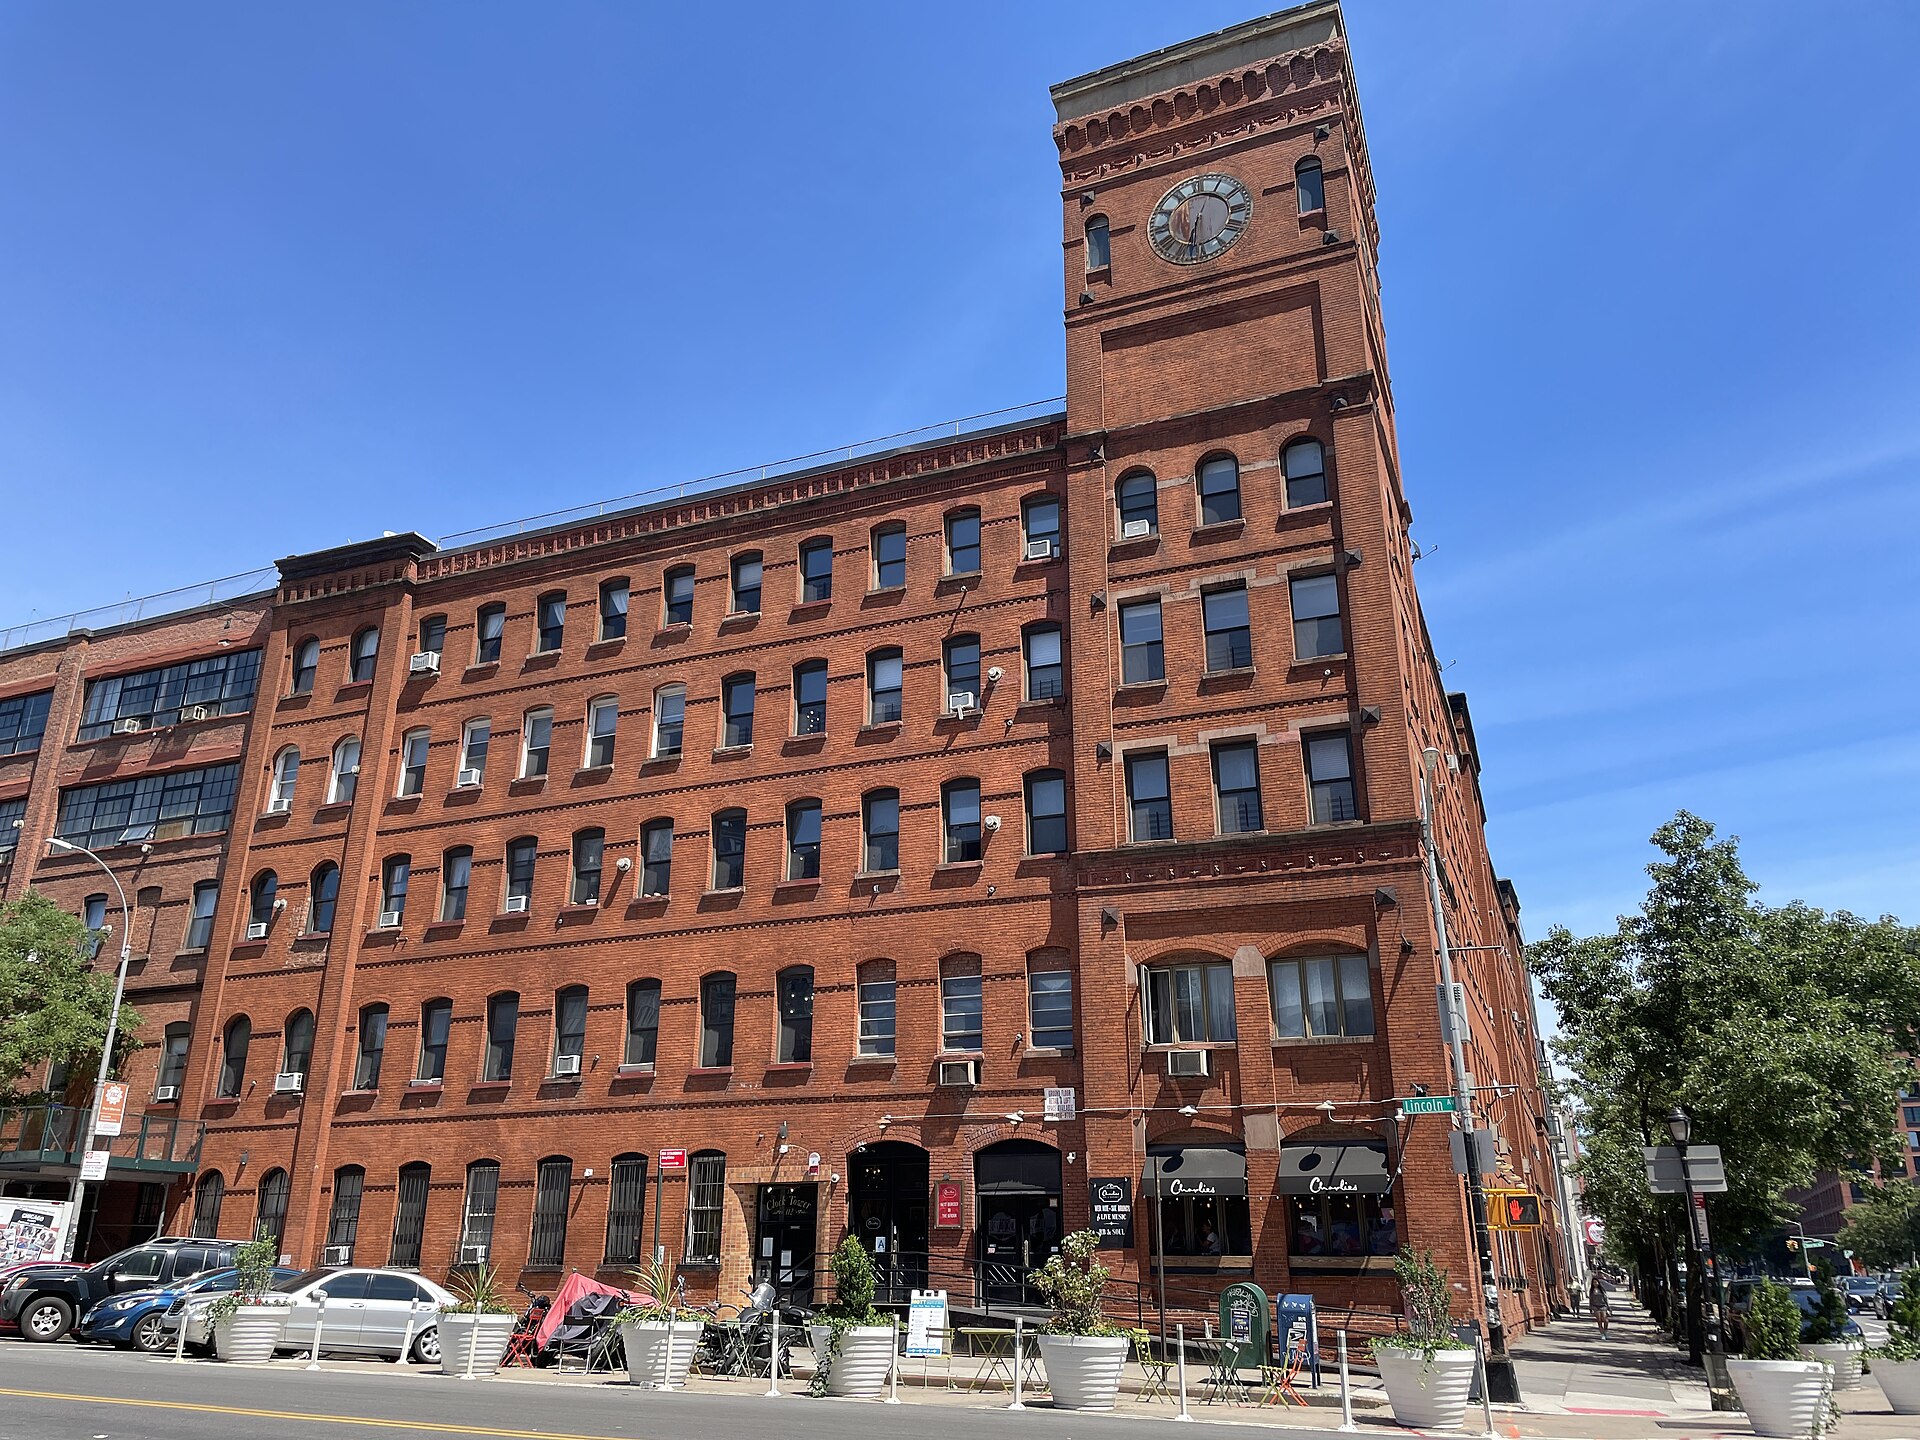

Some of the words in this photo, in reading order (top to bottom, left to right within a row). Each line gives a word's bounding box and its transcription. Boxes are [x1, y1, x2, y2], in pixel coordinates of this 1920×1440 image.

[1405, 1099, 1444, 1113] Lincoln
[1170, 1179, 1216, 1195] Charlies
[1310, 1176, 1358, 1193] Charlies
[767, 1195, 786, 1210] Clock
[789, 1195, 812, 1209] Tower
[878, 1240, 885, 1248] A
